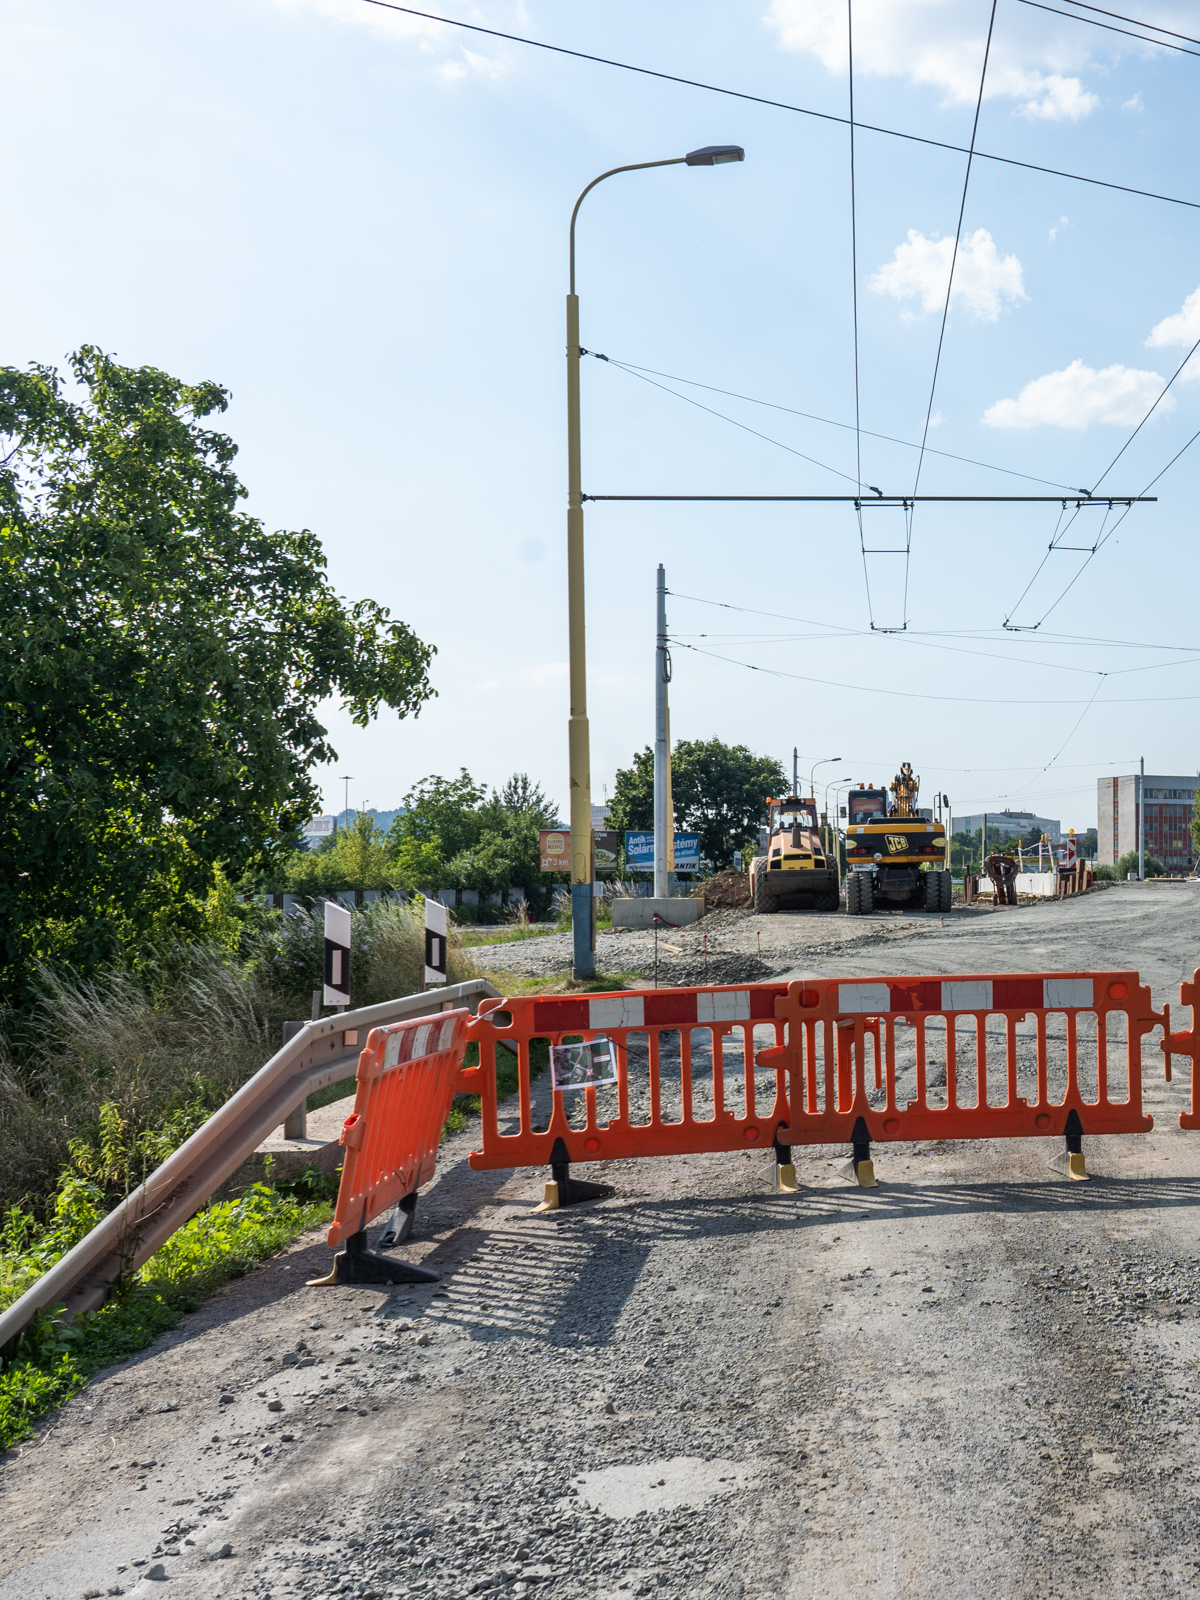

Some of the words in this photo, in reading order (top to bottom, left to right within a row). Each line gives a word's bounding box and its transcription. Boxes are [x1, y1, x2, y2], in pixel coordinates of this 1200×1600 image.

[628, 835, 646, 845] Antik
[628, 843, 654, 855] Solárn
[673, 838, 698, 849] stémy
[888, 836, 907, 851] JCB
